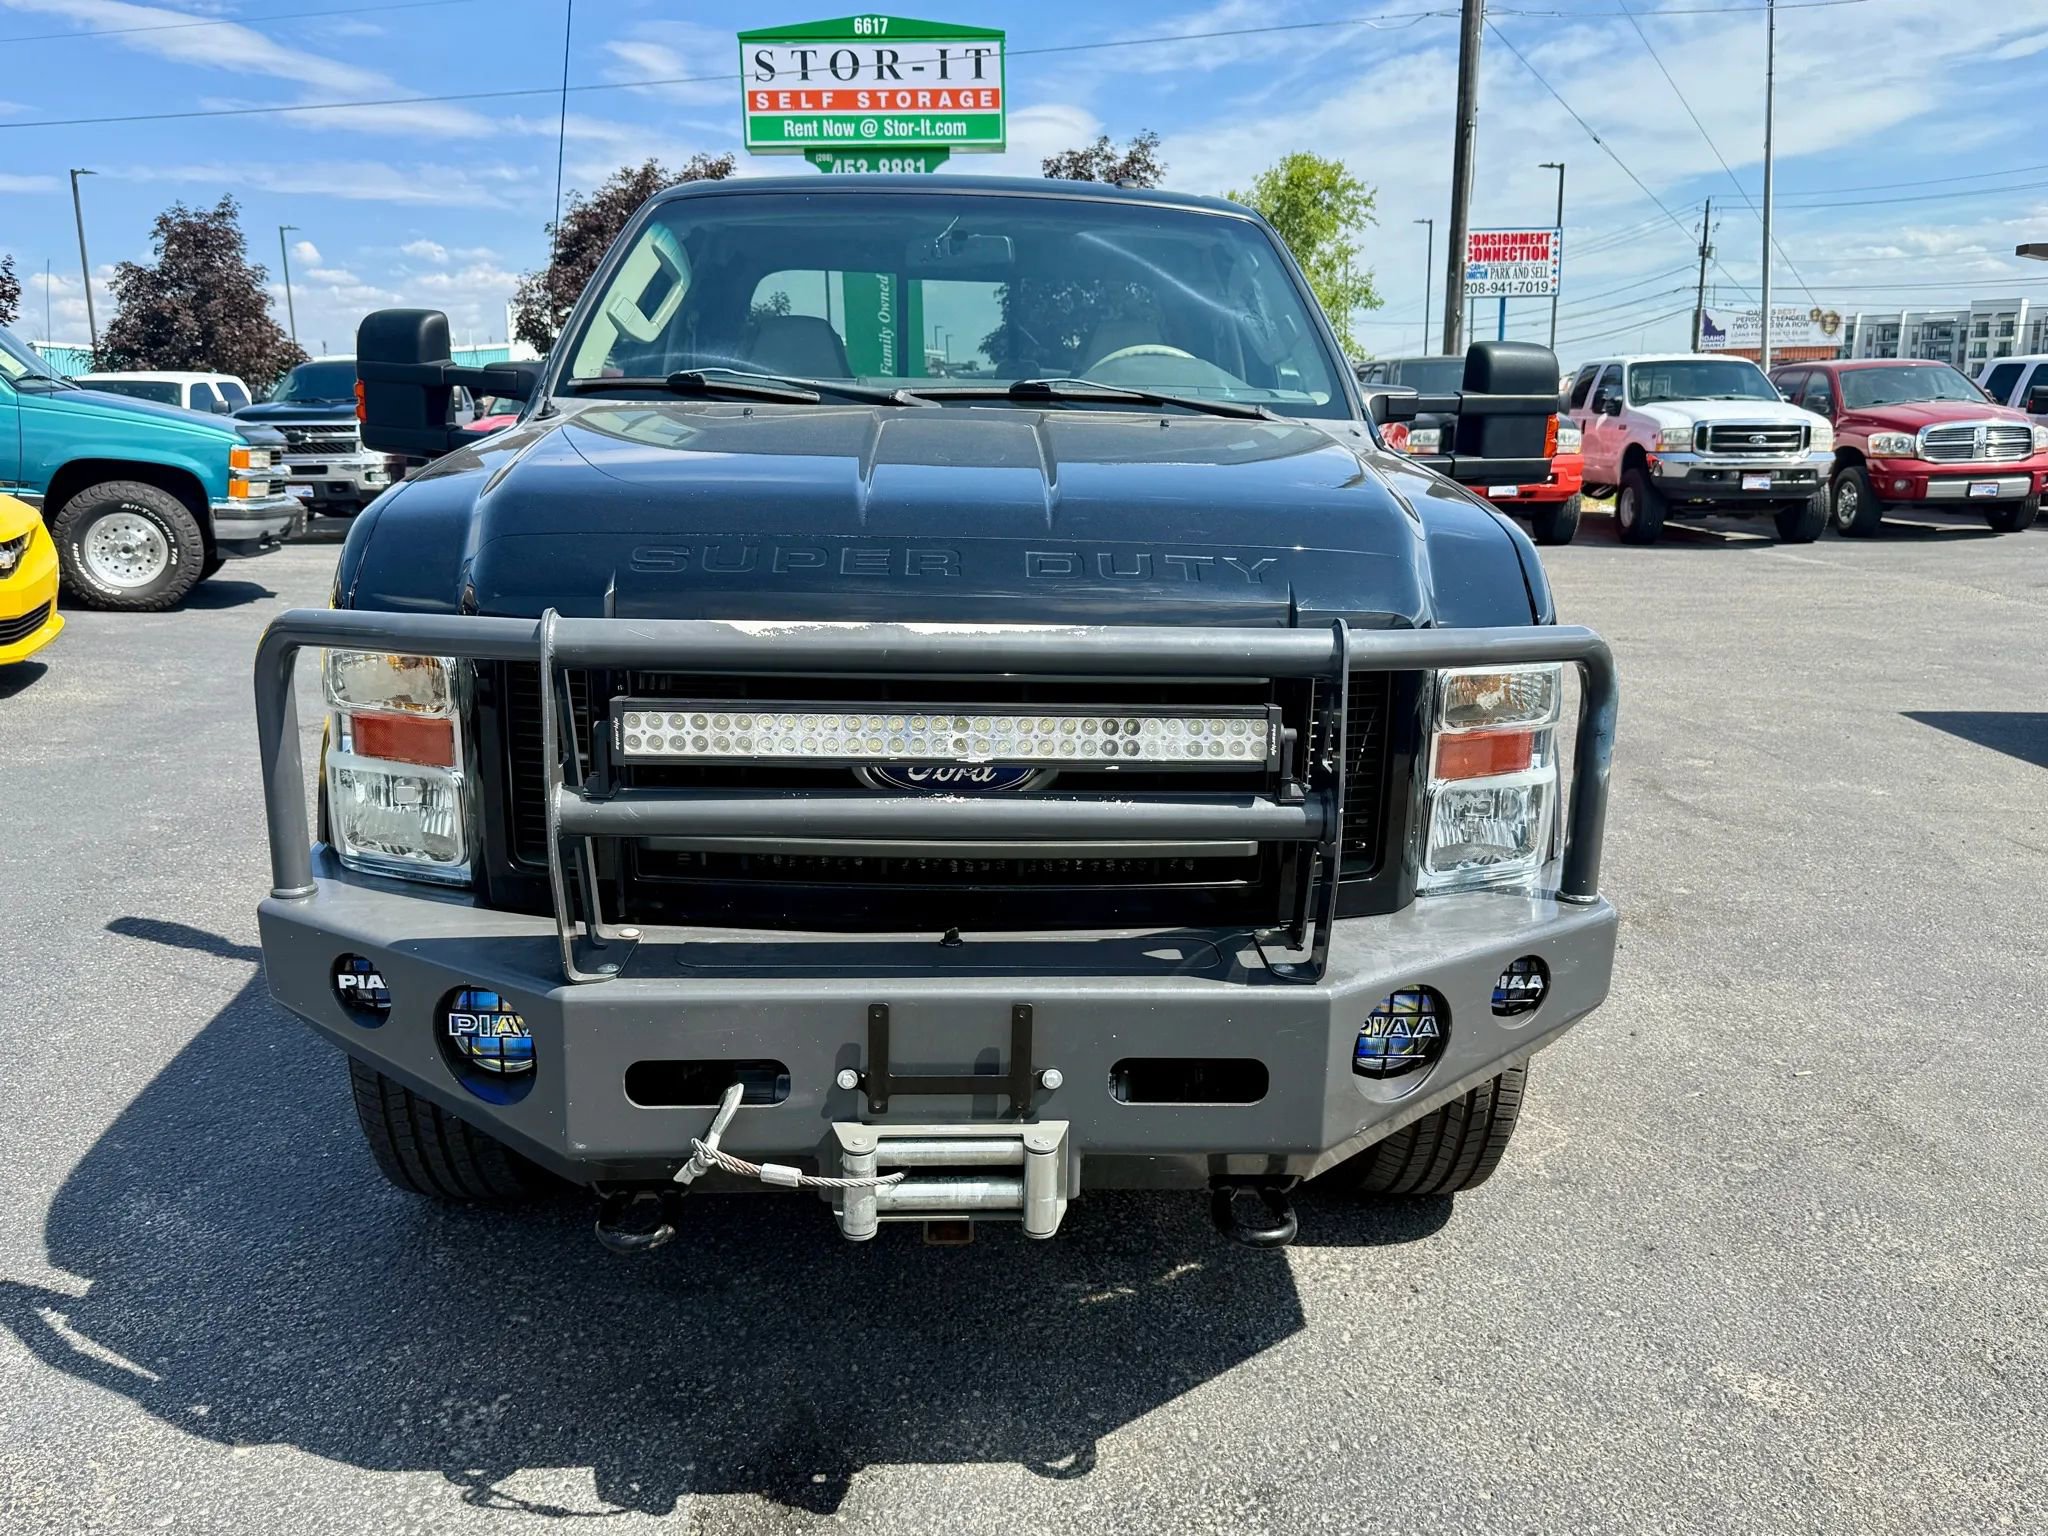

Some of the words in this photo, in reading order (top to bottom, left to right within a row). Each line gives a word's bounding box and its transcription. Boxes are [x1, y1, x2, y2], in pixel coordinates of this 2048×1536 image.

[854, 17, 888, 35] 6617
[754, 48, 991, 83] STOR-IT
[756, 92, 834, 109] SELF
[857, 90, 993, 109] STORAGE
[784, 120, 818, 138] Rent
[823, 120, 855, 137] Now
[860, 118, 878, 139] @
[883, 119, 967, 137] Stor-It.com
[815, 153, 833, 164] (208)
[831, 158, 926, 174] 453-8881
[1490, 268, 1510, 280] PARK
[1512, 267, 1529, 279] AND
[1530, 266, 1549, 279] SELL
[1464, 281, 1548, 294] 208-941-7019
[876, 273, 890, 323] Owned
[1701, 334, 1725, 342] IDAHO
[879, 327, 894, 376] Family
[121, 503, 175, 543] All-Terrain
[629, 545, 961, 576] SUPER
[1025, 550, 1278, 584] DUTY
[338, 974, 388, 989] PIA
[1494, 975, 1544, 989] IAA
